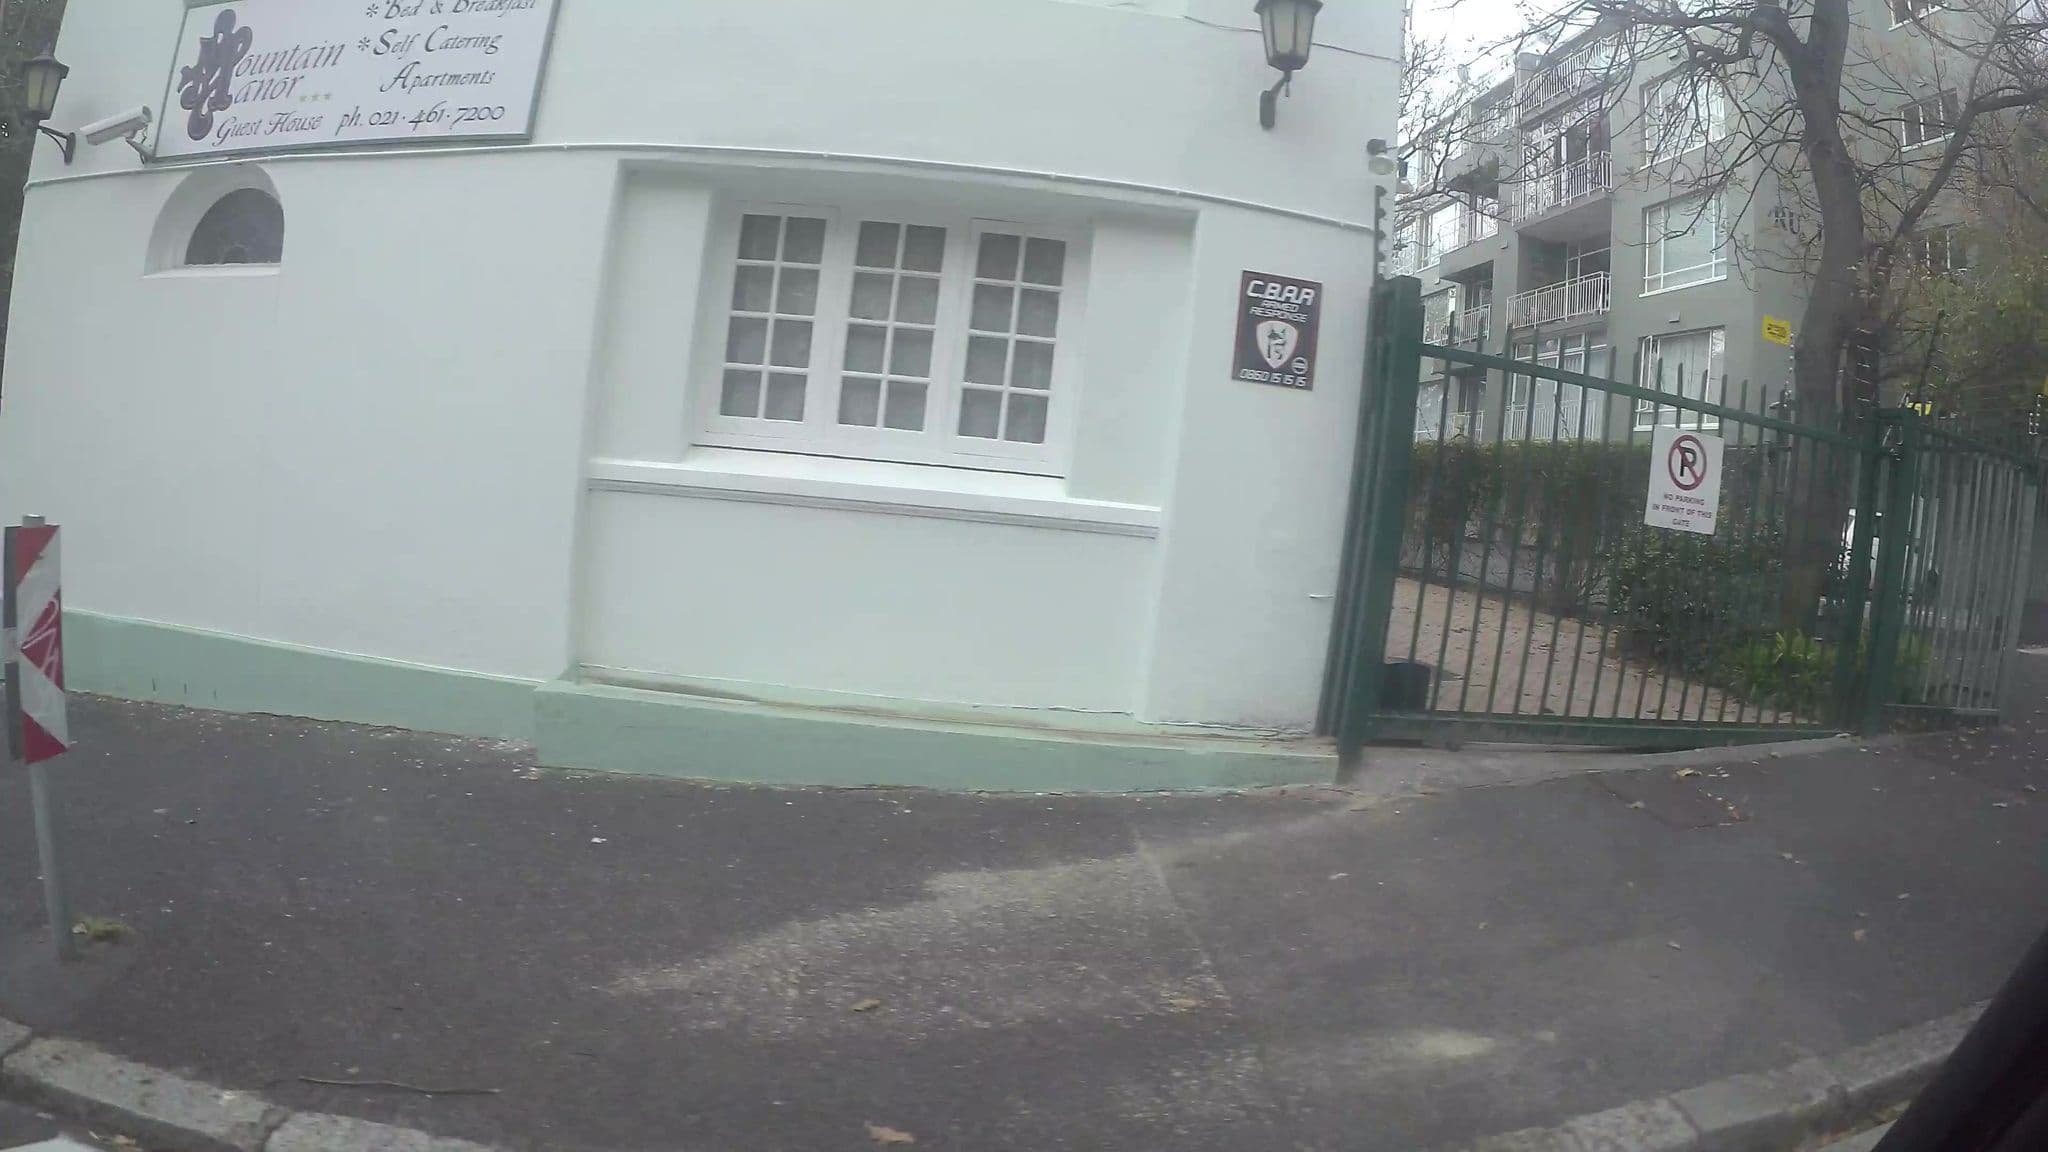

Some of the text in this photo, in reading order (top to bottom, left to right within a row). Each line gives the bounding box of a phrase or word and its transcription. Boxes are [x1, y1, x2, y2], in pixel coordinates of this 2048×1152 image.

[373, 25, 503, 60] Self Catering
[379, 61, 496, 95] Apartments
[212, 111, 323, 147] Guest House
[1248, 306, 1308, 323] RESPONSE
[1661, 504, 1685, 514] FRONT
[1687, 508, 1696, 516] OF
[1697, 510, 1713, 519] THIS
[1675, 495, 1705, 506] PARKING
